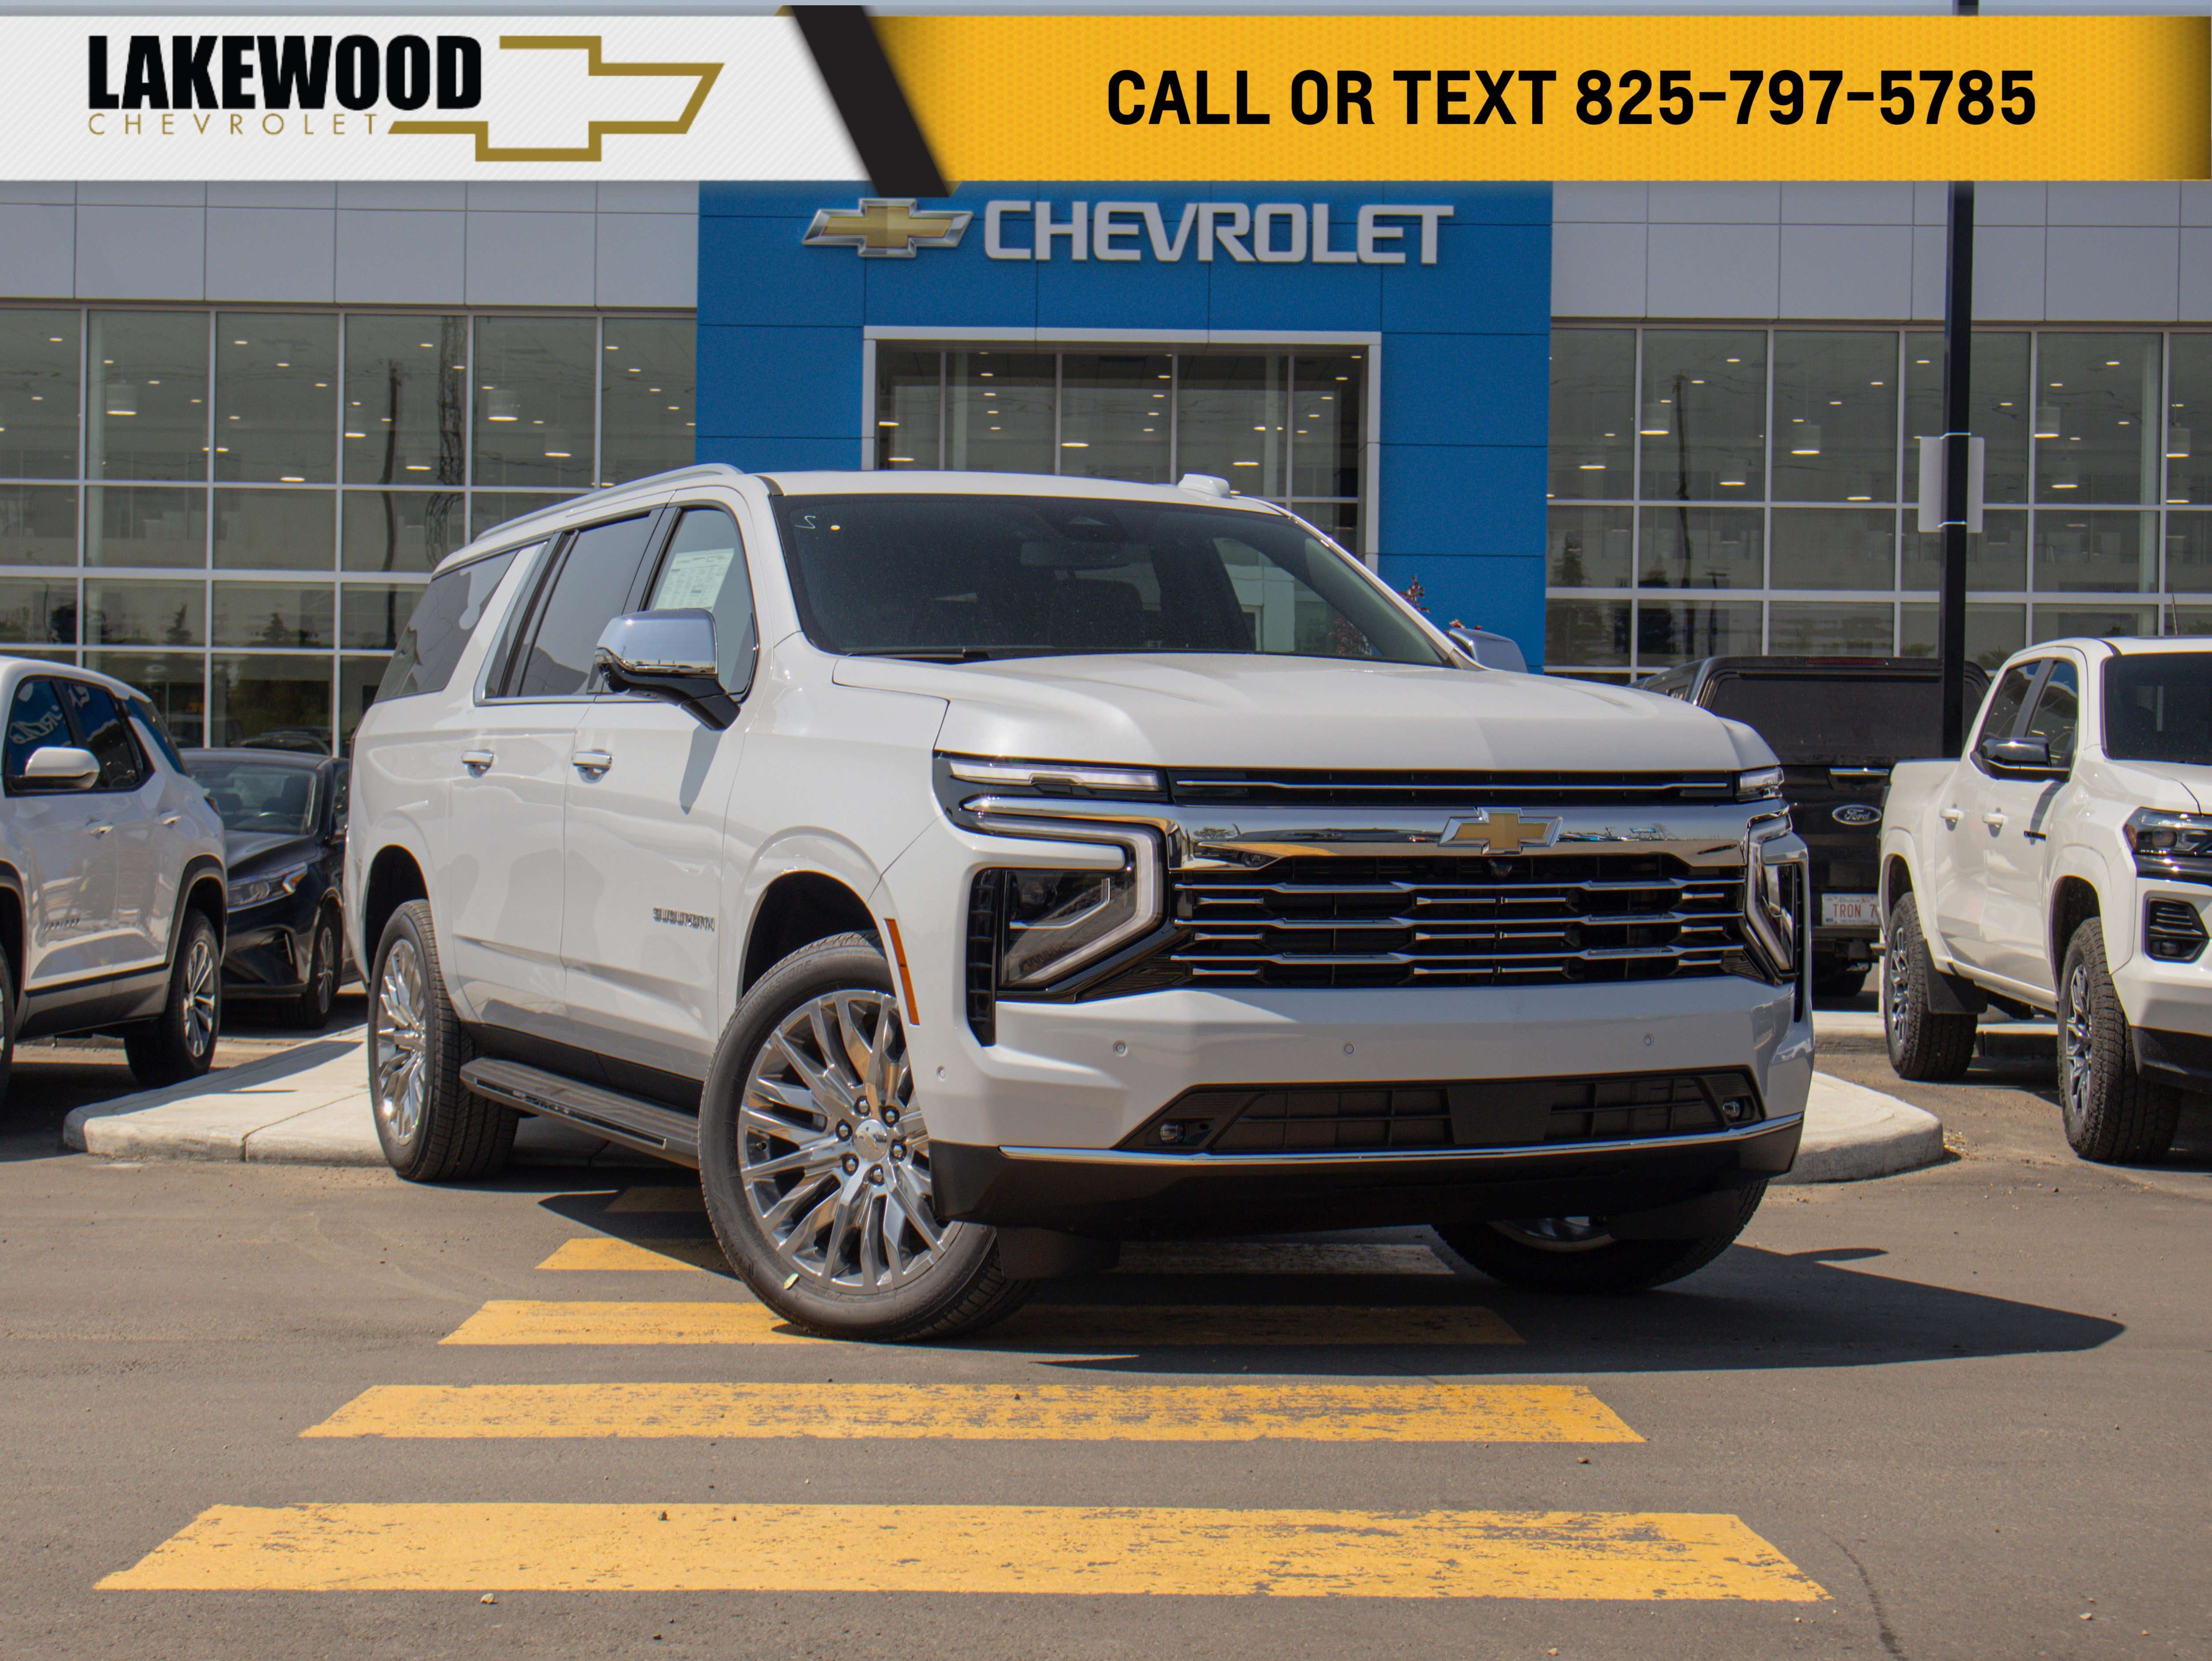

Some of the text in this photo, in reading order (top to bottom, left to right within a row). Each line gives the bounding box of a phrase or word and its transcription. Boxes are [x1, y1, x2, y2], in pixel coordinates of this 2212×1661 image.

[985, 201, 1453, 263] CHEVROLET
[1844, 808, 1871, 820] Ford
[1833, 904, 1861, 918] TRON
